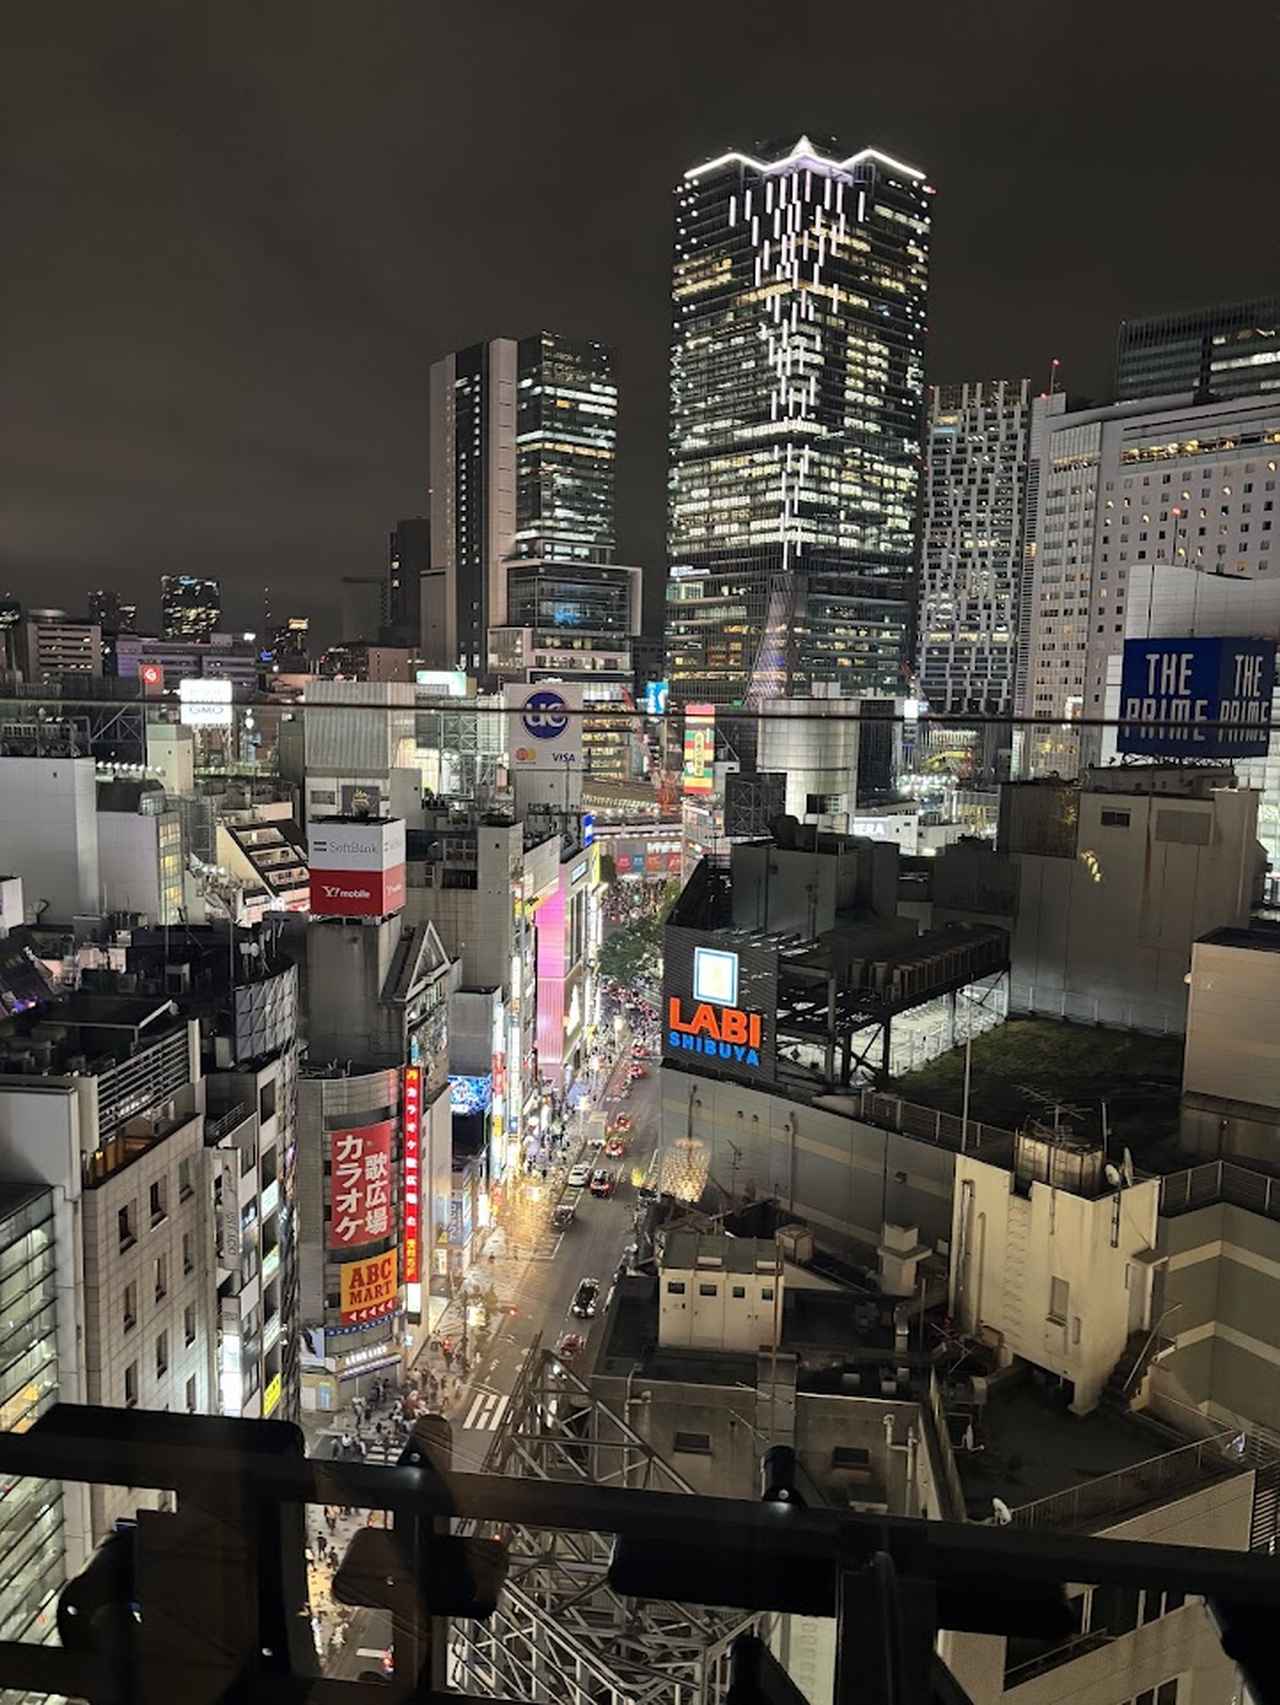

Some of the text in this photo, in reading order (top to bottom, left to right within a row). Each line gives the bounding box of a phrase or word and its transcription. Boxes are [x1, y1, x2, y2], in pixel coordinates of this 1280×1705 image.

[1145, 653, 1194, 696] THE
[1235, 654, 1264, 698] THE
[1124, 697, 1209, 742] PRIME
[1217, 700, 1269, 743] PRIME
[552, 752, 576, 762] VISA
[328, 840, 378, 854] SoftBank
[669, 996, 762, 1049] LABI
[668, 1031, 760, 1067] SHIBUYA
[335, 1134, 365, 1242] カラオケ
[365, 1151, 389, 1235] 歌広場
[349, 1257, 392, 1290] ABC
[349, 1279, 392, 1305] MART
